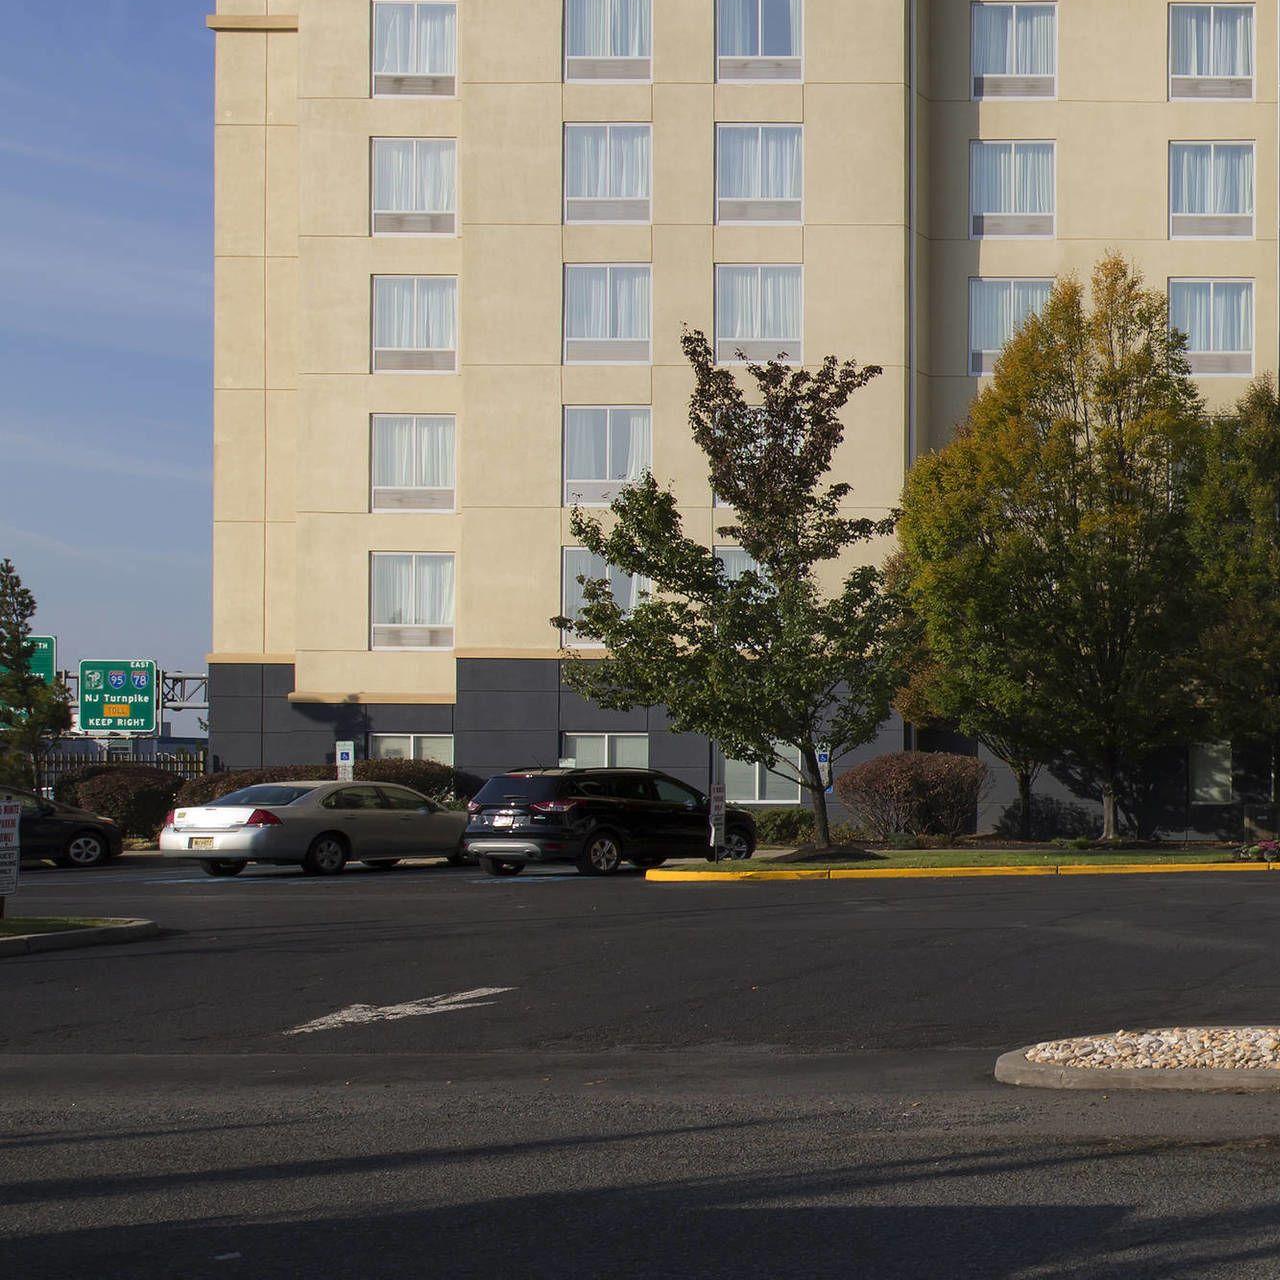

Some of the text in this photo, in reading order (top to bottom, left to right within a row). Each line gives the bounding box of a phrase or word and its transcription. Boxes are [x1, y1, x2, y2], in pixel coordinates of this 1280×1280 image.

[111, 675, 147, 686] 95 78
[85, 694, 150, 704] NJ Turnpike
[88, 718, 145, 726] KEEP RIGHT
